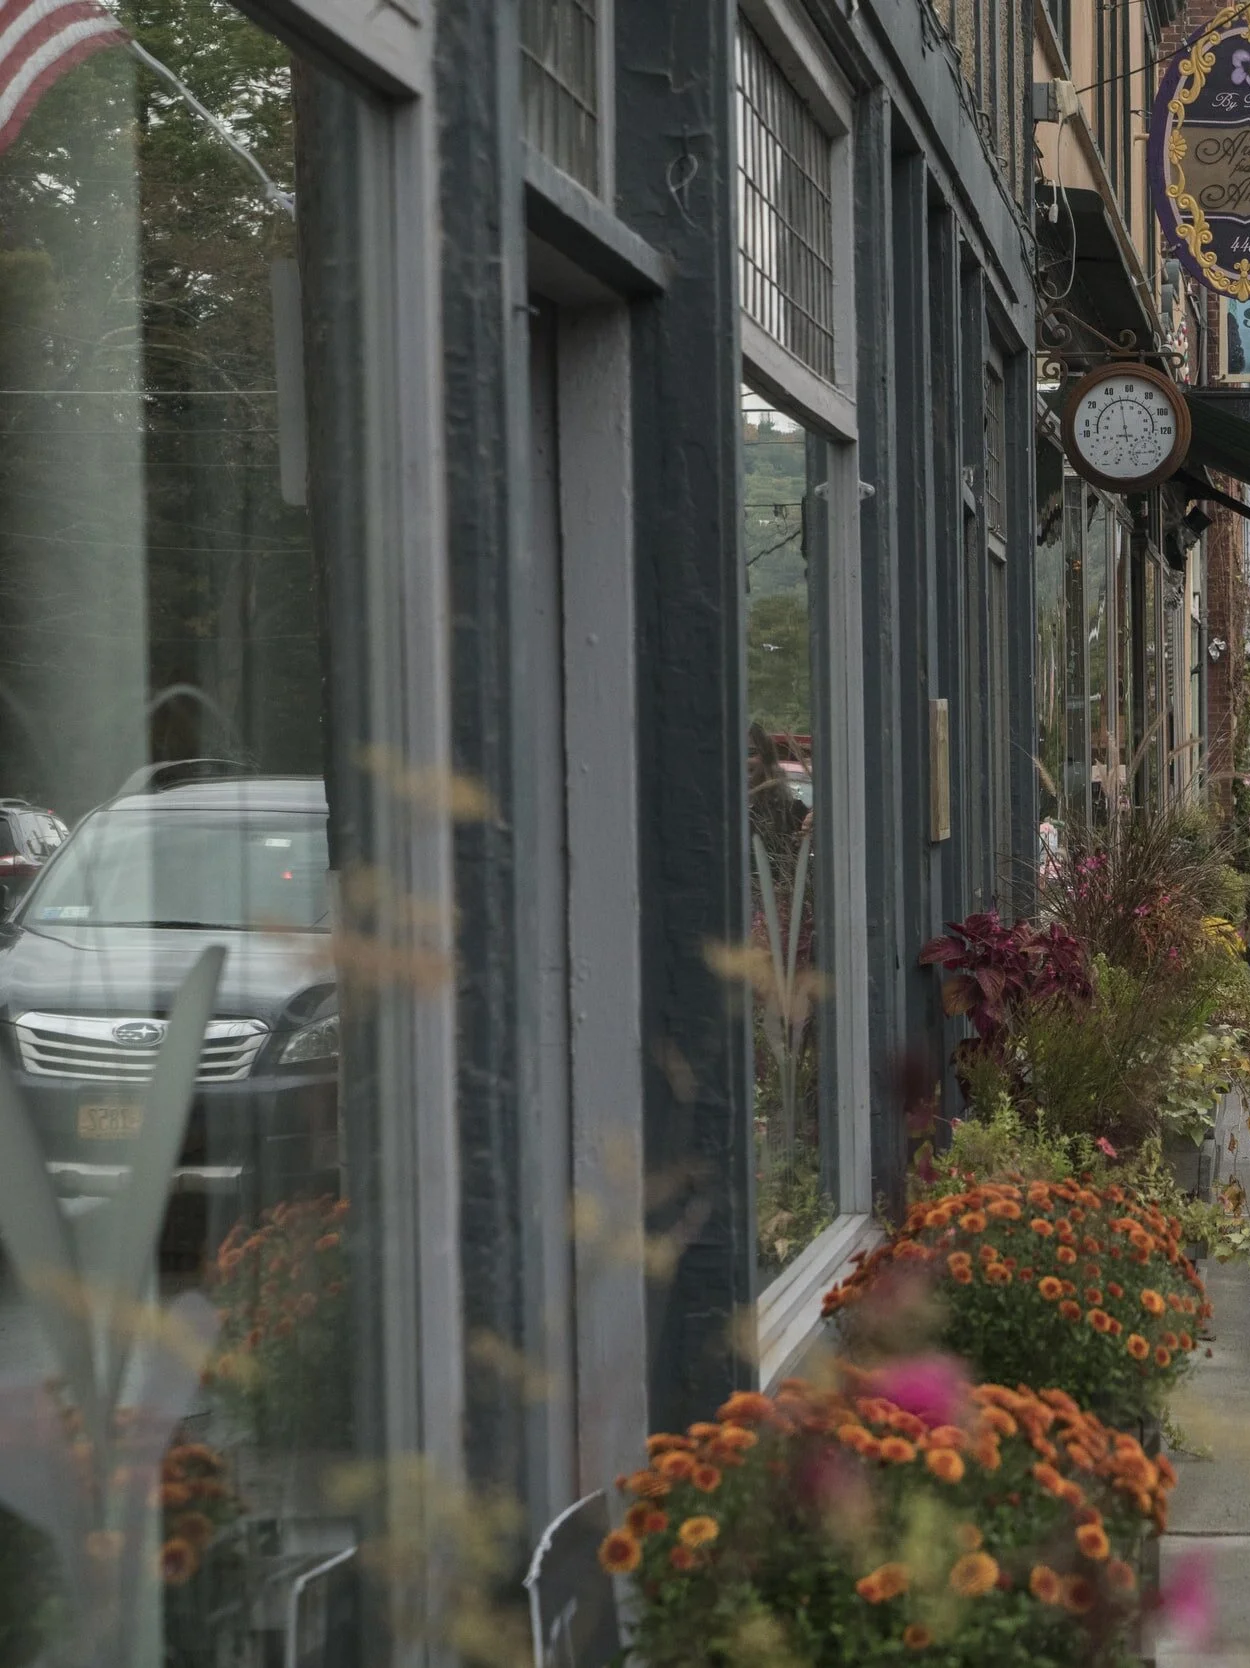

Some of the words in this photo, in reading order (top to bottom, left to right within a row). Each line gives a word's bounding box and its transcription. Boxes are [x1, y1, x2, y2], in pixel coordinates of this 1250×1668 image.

[1211, 92, 1239, 112] By
[1104, 387, 1114, 396] 40
[1124, 384, 1134, 393] 60
[1144, 392, 1154, 400] 80
[1087, 401, 1097, 409] 20
[1156, 408, 1169, 416] 100
[1084, 419, 1090, 428] 0
[1160, 426, 1172, 435] 120
